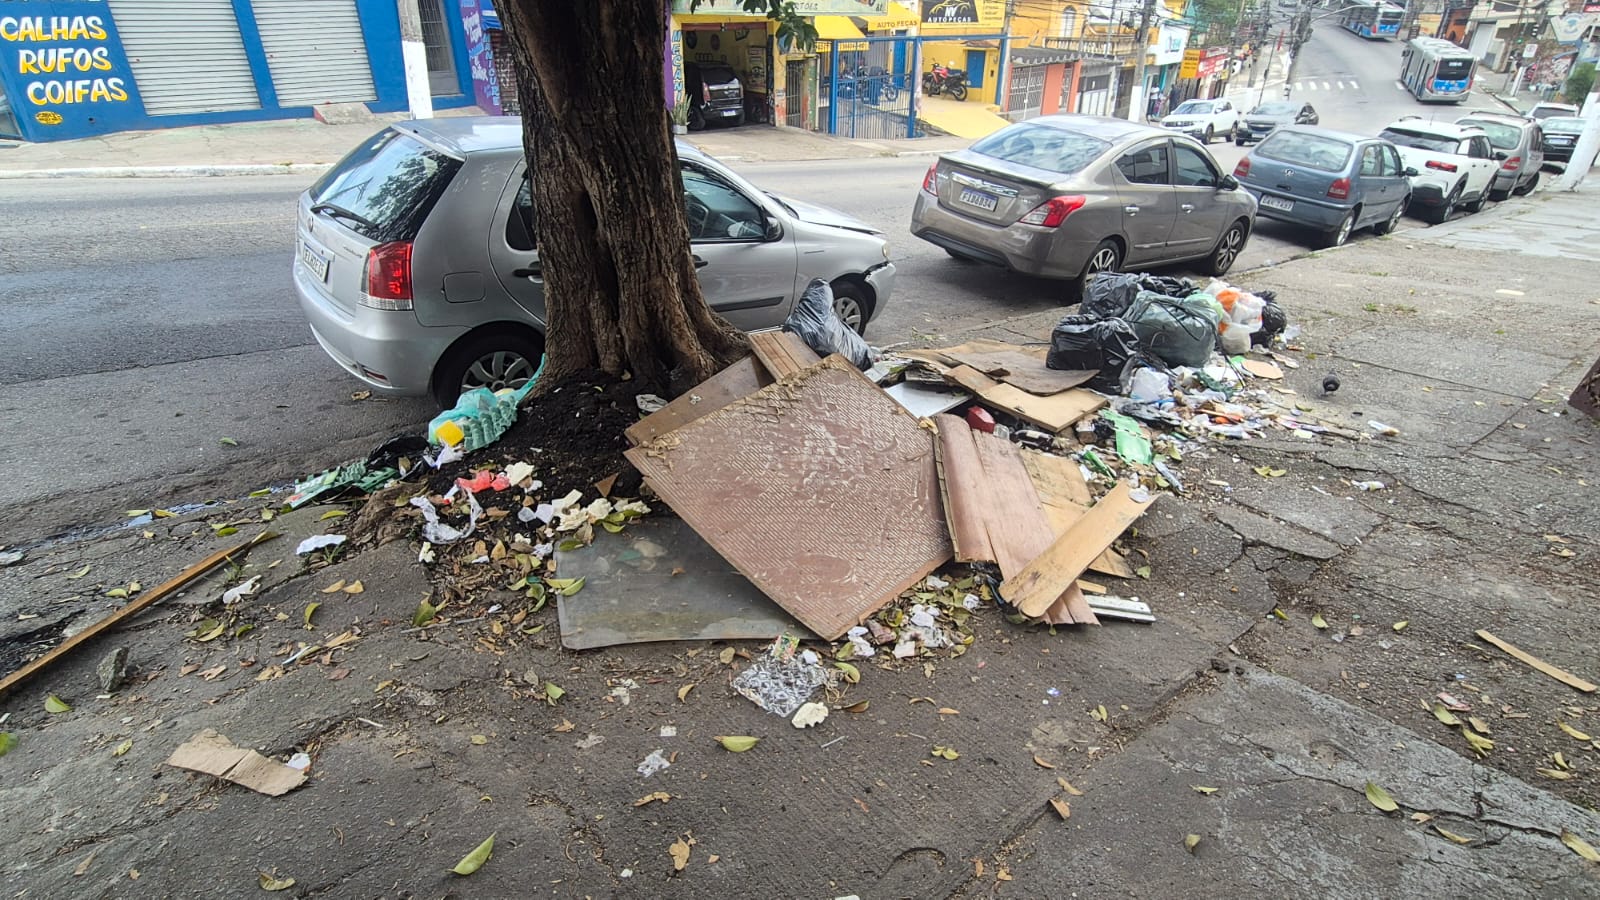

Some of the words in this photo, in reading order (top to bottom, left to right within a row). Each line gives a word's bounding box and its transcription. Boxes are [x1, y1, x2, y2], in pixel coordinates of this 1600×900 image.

[0, 16, 108, 41] CALHAS
[19, 47, 112, 74] RUFOS
[27, 77, 128, 106] COIFAS
